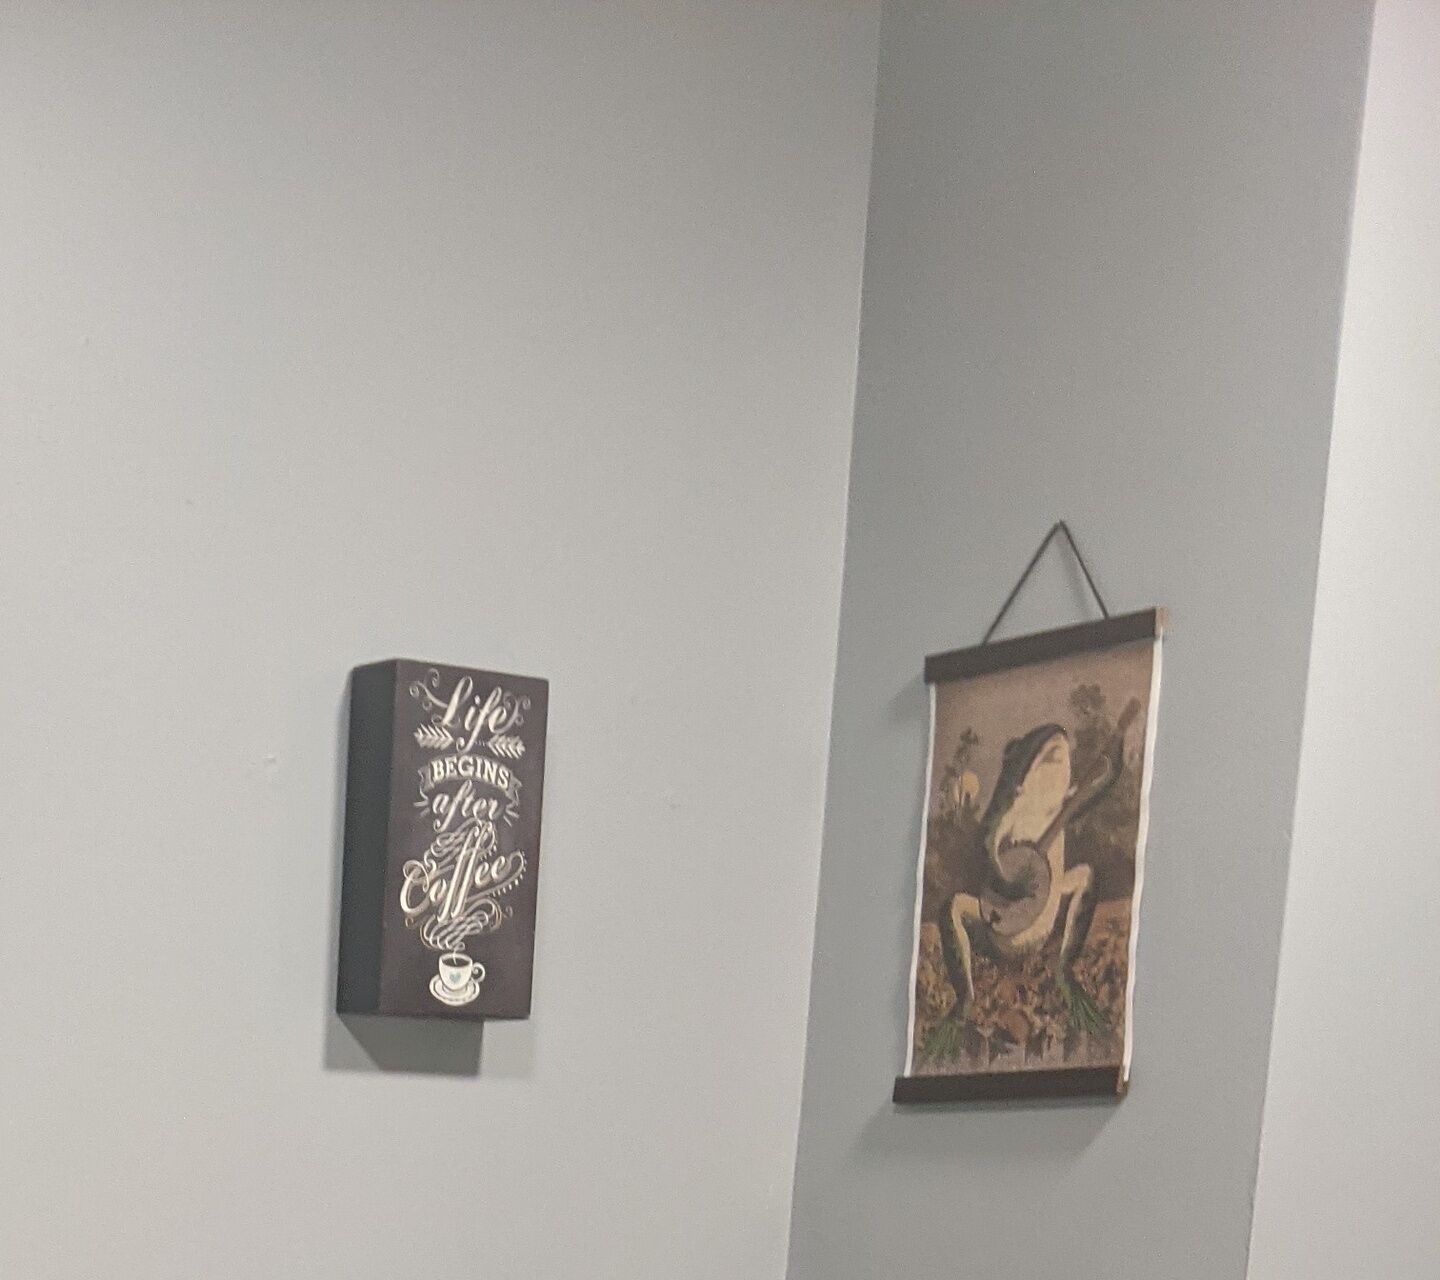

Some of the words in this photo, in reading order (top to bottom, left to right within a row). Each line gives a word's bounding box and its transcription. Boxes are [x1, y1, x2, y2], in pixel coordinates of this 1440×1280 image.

[415, 673, 526, 754] Life
[430, 753, 510, 788] BEGINS
[432, 780, 504, 832] after
[400, 822, 525, 922] Coffee
